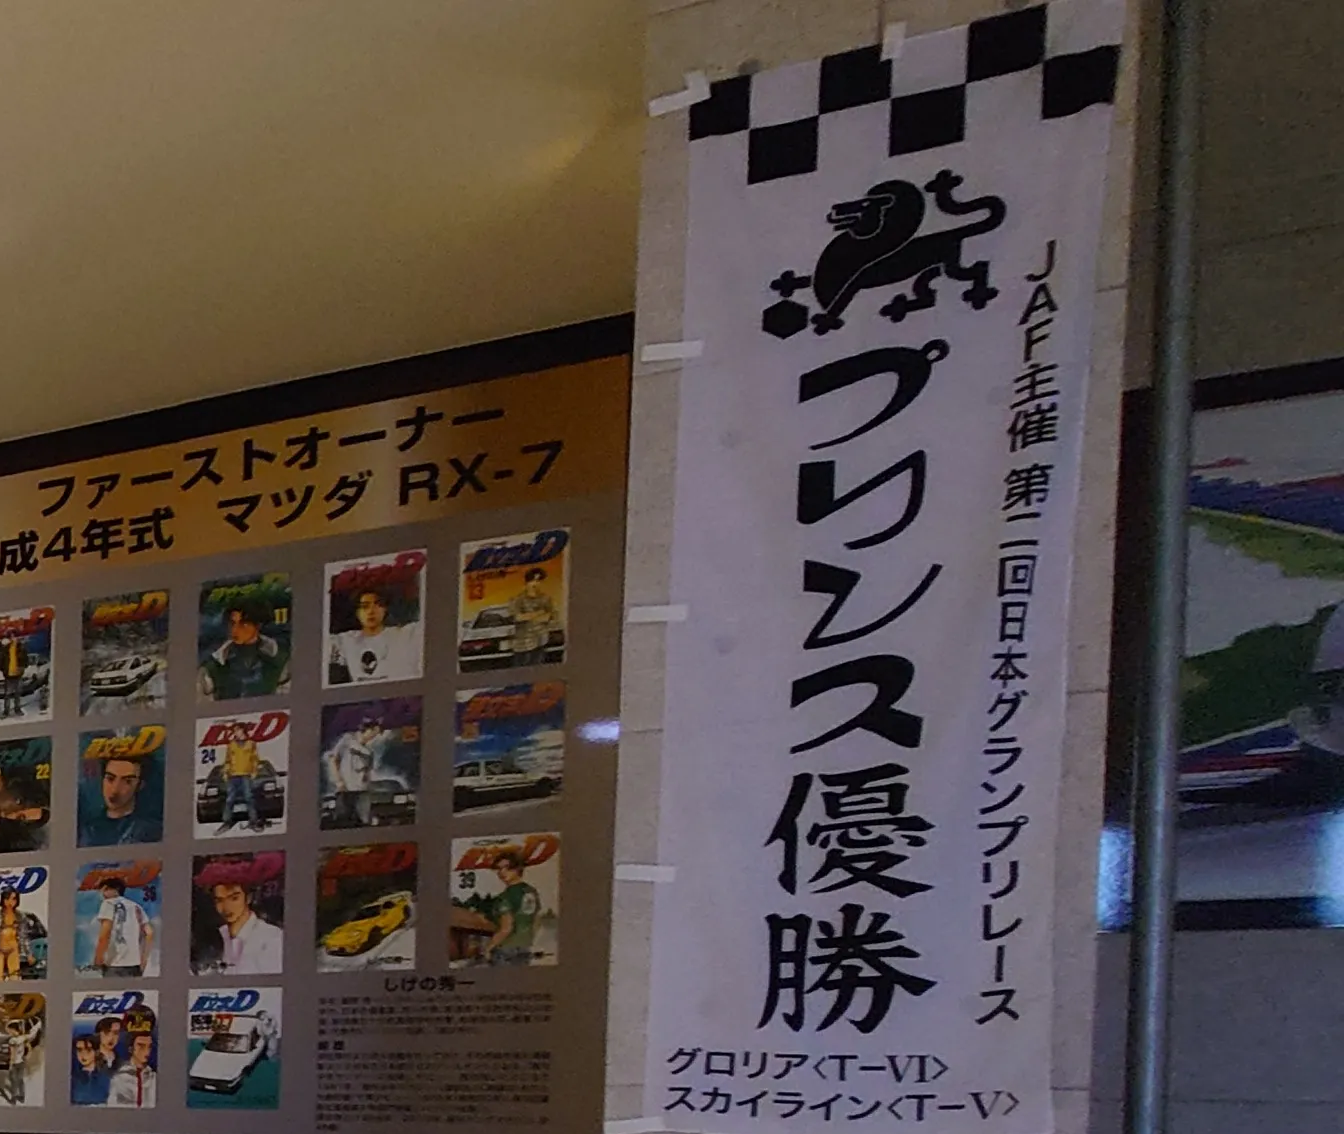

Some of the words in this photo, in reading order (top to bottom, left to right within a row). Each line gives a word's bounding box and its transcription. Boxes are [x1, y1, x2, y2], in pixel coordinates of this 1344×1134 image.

[36, 404, 506, 518] ファーストオーナー
[216, 470, 375, 533] マツダ
[398, 439, 565, 505] RX-7
[757, 338, 950, 1034] プリンス優勝
[34, 762, 51, 780] 22
[201, 749, 216, 764] 24
